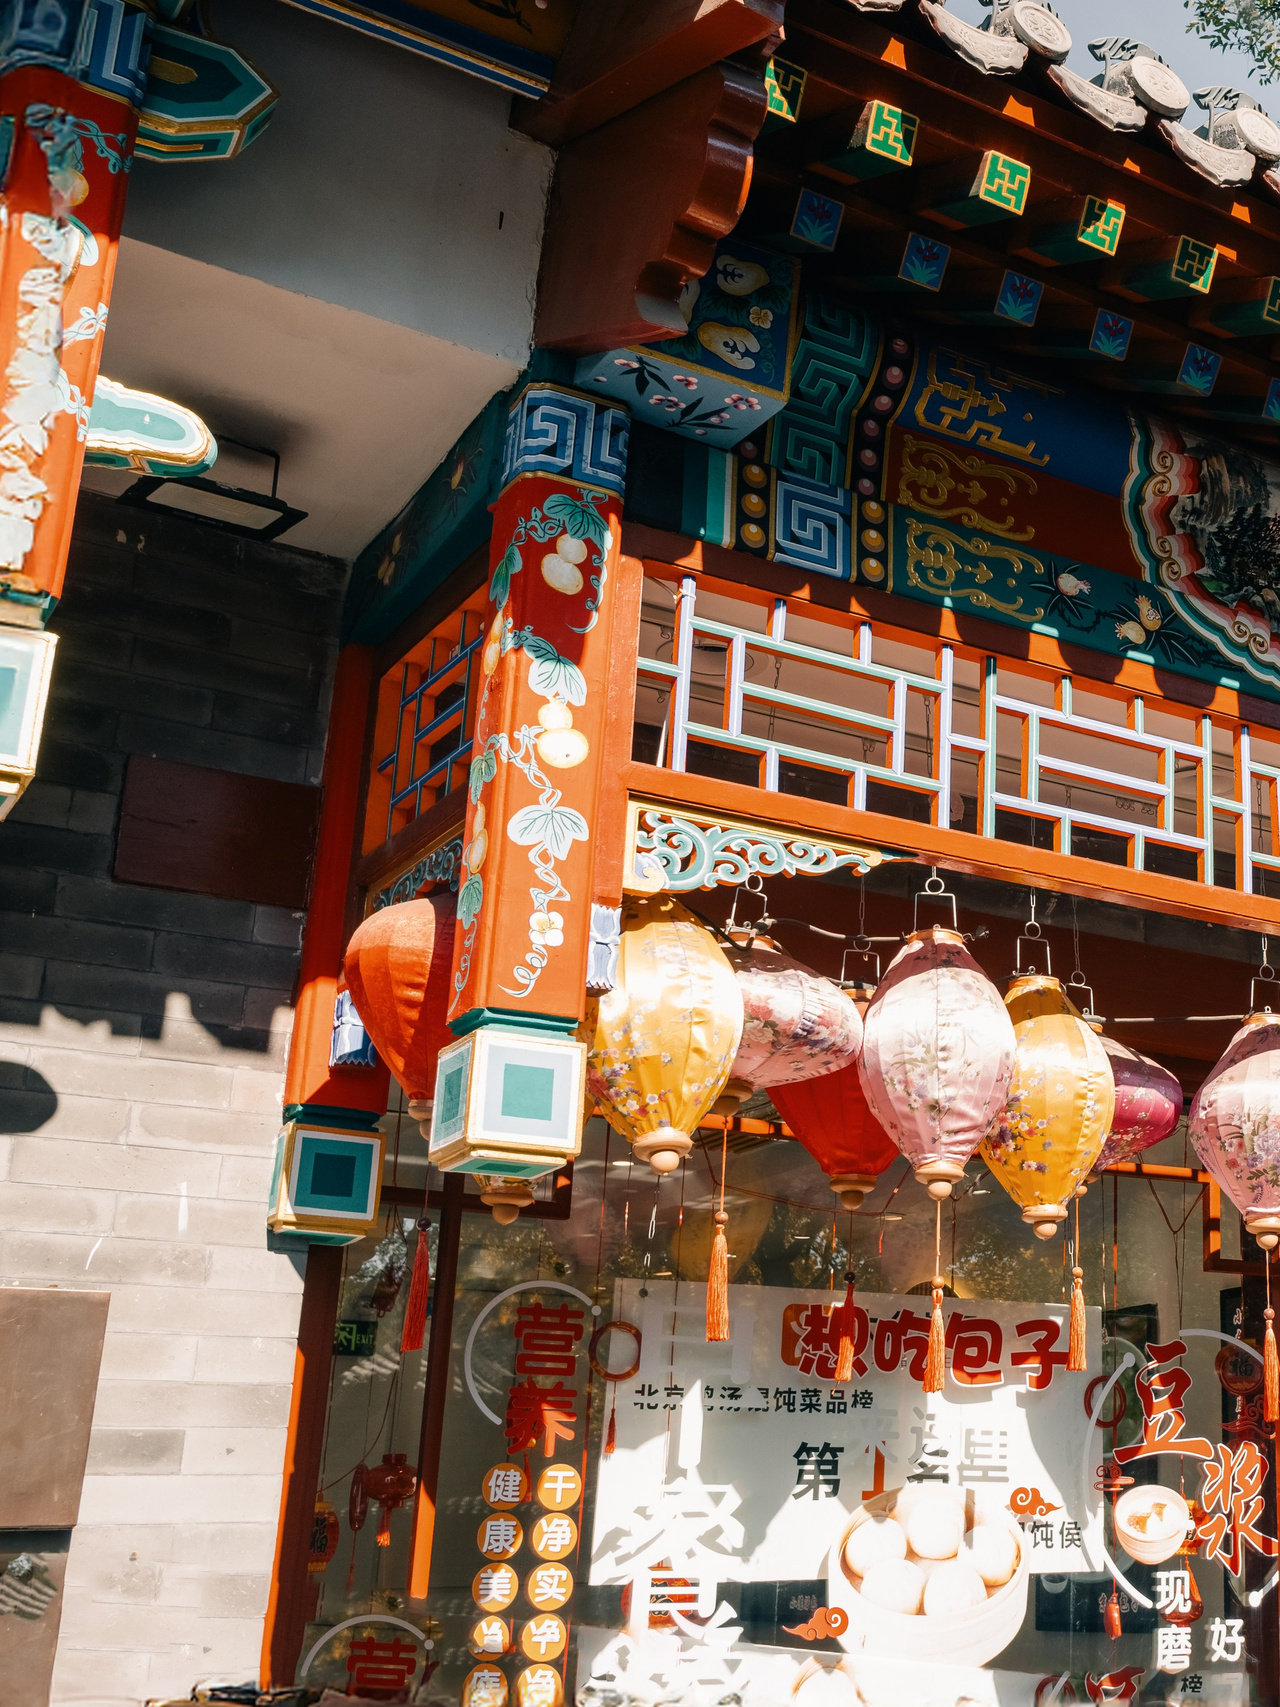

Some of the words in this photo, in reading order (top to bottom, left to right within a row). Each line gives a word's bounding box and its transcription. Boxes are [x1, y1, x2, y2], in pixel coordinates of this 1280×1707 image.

[356, 1334, 374, 1344] EXIT
[504, 1302, 585, 1459] 营养
[798, 1303, 1071, 1391] 想吃包子
[1113, 1339, 1279, 1578] 豆浆
[1018, 1521, 1082, 1549] 饨侯
[1155, 1570, 1192, 1670] 现磨
